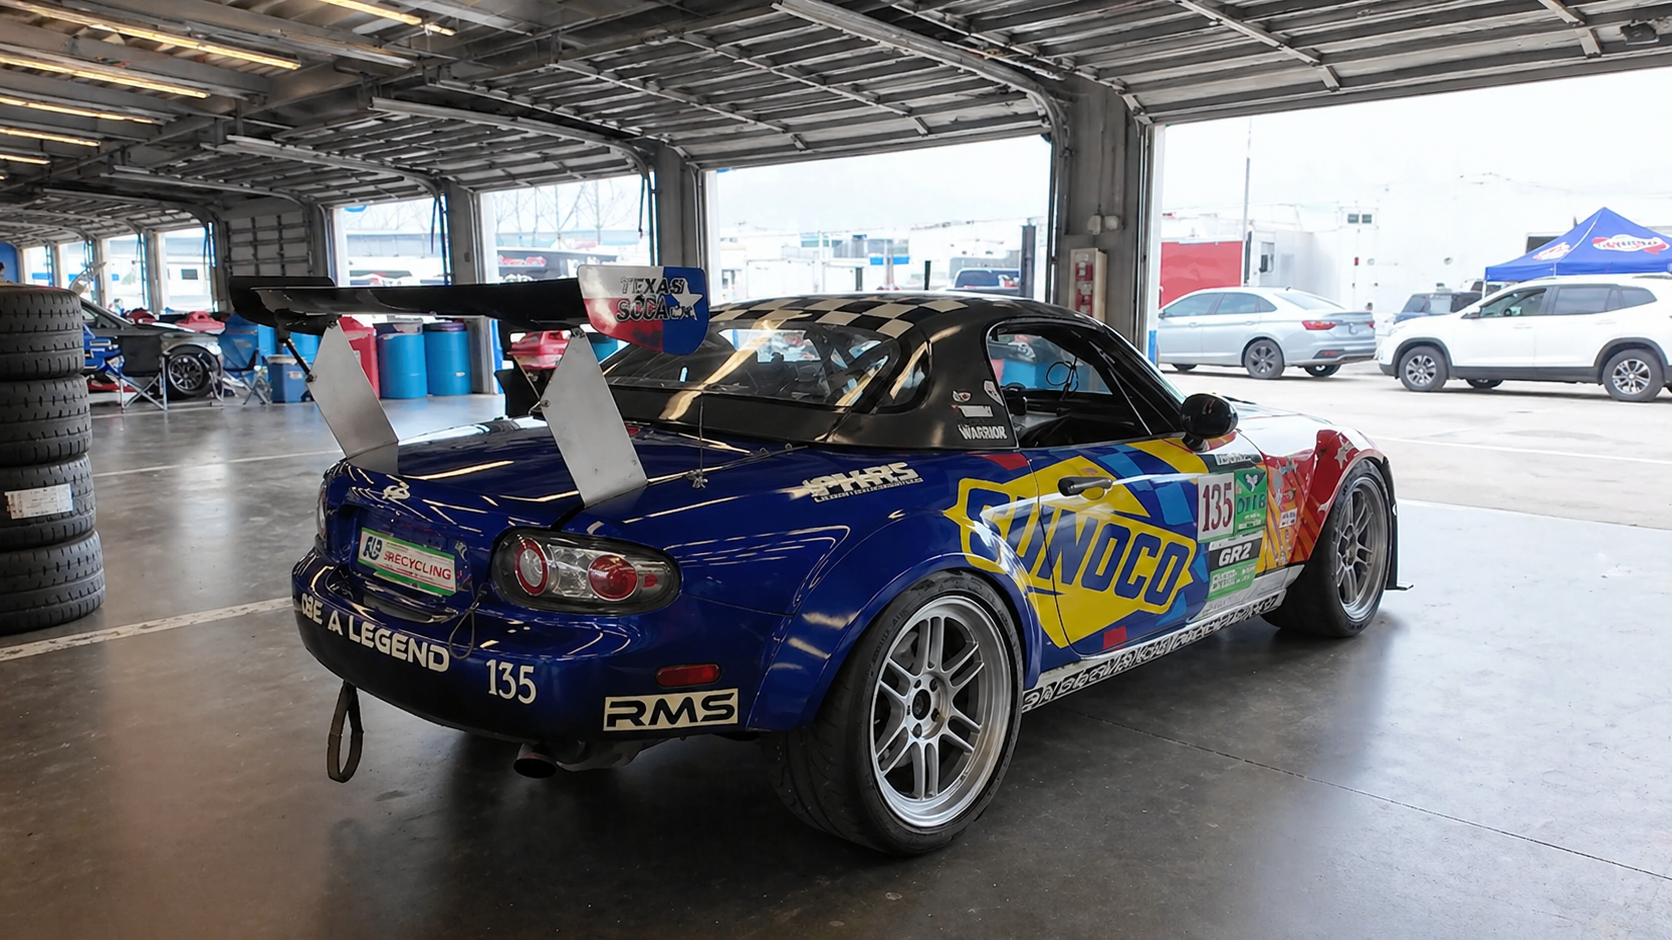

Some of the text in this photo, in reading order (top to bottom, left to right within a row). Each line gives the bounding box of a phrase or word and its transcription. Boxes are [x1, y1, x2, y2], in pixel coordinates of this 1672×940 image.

[620, 277, 686, 295] TEXAS
[957, 424, 1008, 440] WARRIOR
[1202, 481, 1233, 532] 135
[966, 487, 1191, 607] SUNOCO
[1218, 542, 1252, 567] GR2
[327, 609, 343, 636] A
[348, 614, 450, 673] LEGEND
[486, 659, 537, 704] 135
[606, 692, 736, 728] RMS
